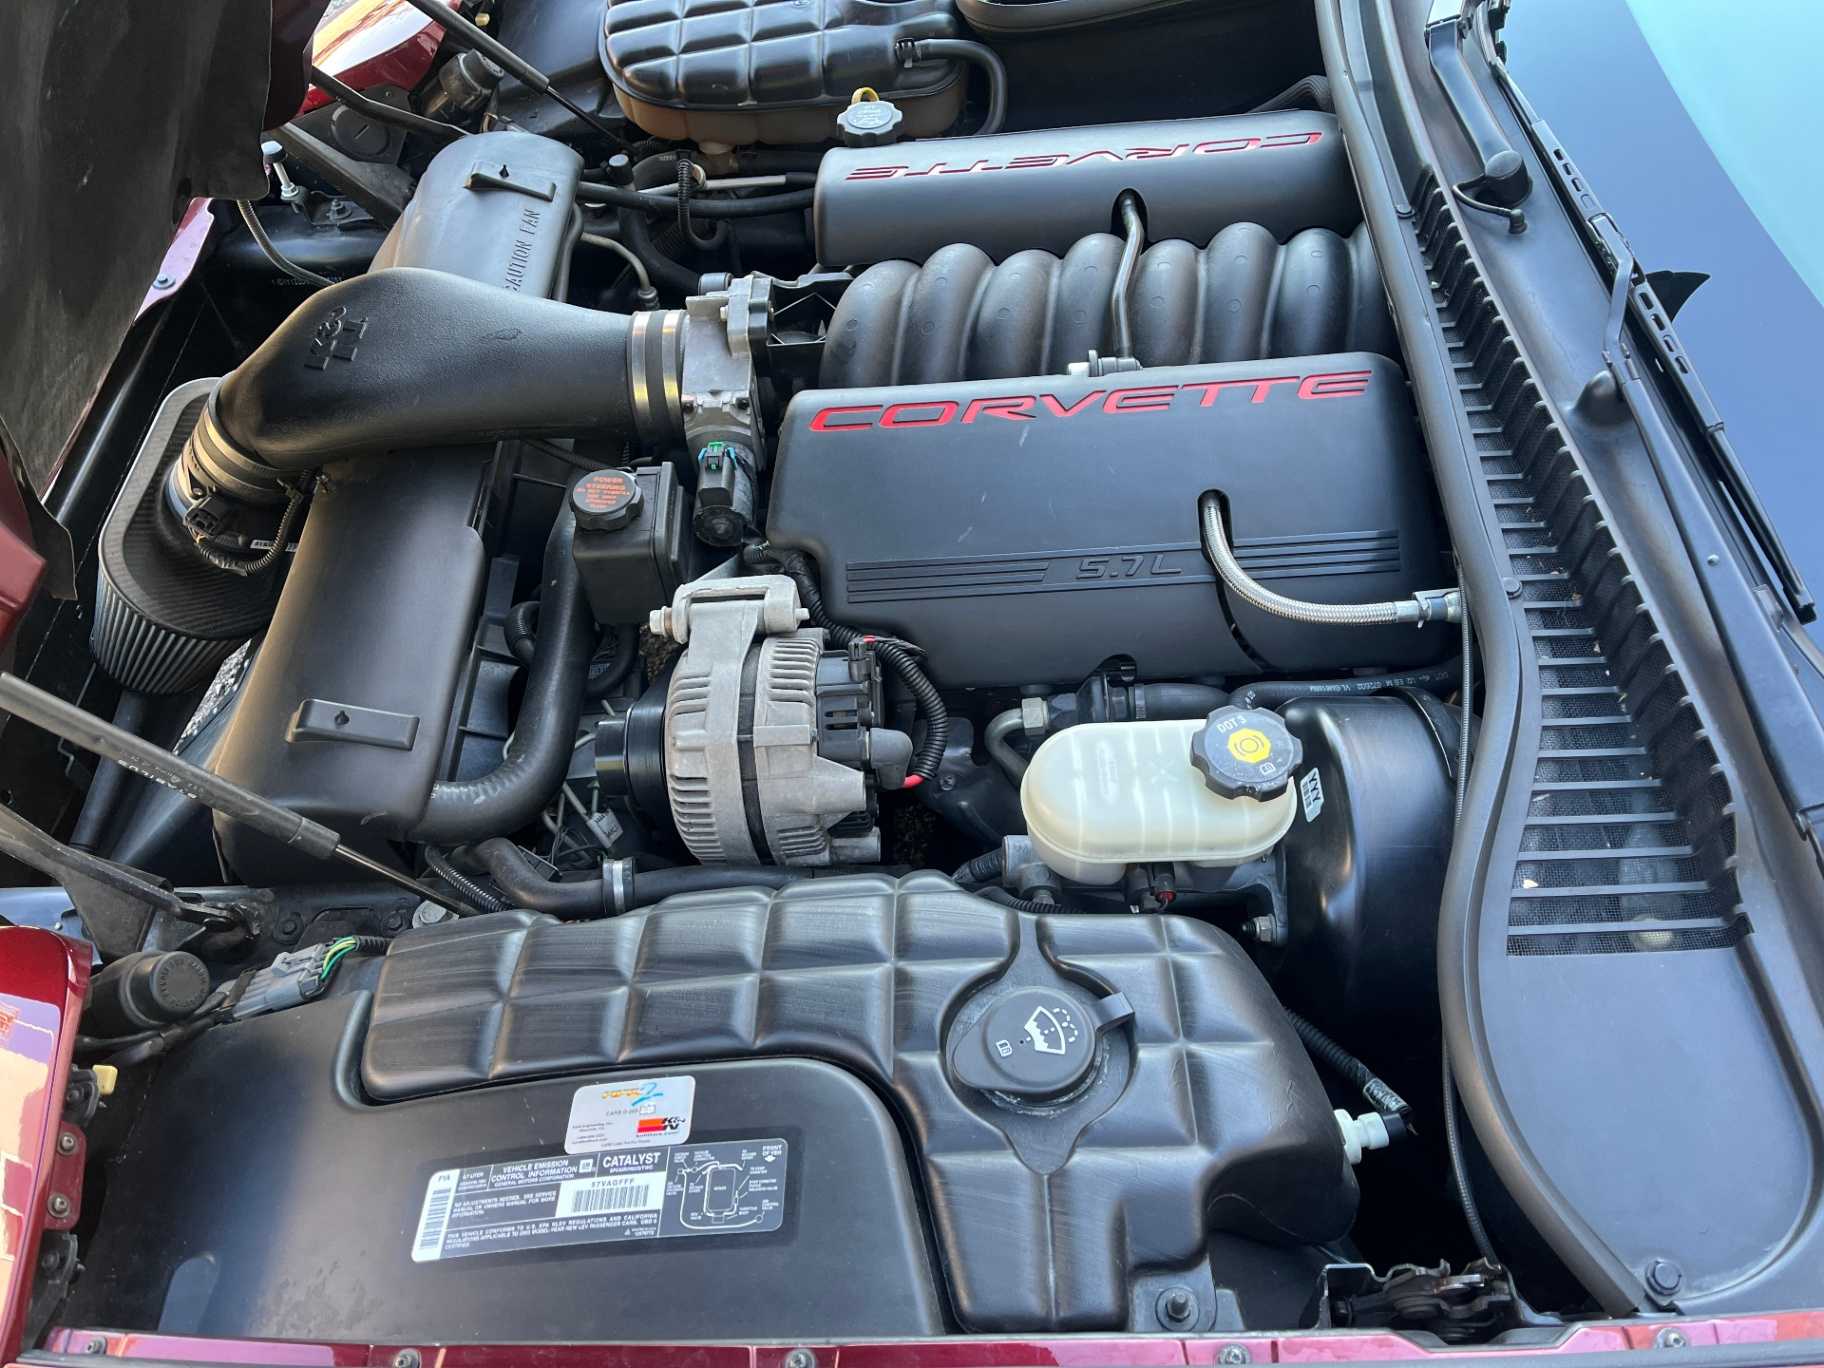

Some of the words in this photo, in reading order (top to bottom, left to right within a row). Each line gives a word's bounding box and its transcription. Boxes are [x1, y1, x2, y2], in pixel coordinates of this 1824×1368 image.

[845, 132, 1322, 180] CORVETTE
[520, 208, 541, 235] FAN
[809, 370, 1372, 431] CORVETTE
[1076, 554, 1182, 580] 5.7L
[1216, 717, 1239, 734] DOT
[1238, 715, 1248, 725] 3
[503, 1161, 532, 1174] VEHICLE
[534, 1159, 569, 1170] EMISSION
[603, 1152, 661, 1168] CATALYST
[491, 1171, 525, 1183] CONTROL
[528, 1166, 578, 1178] INFORMATION
